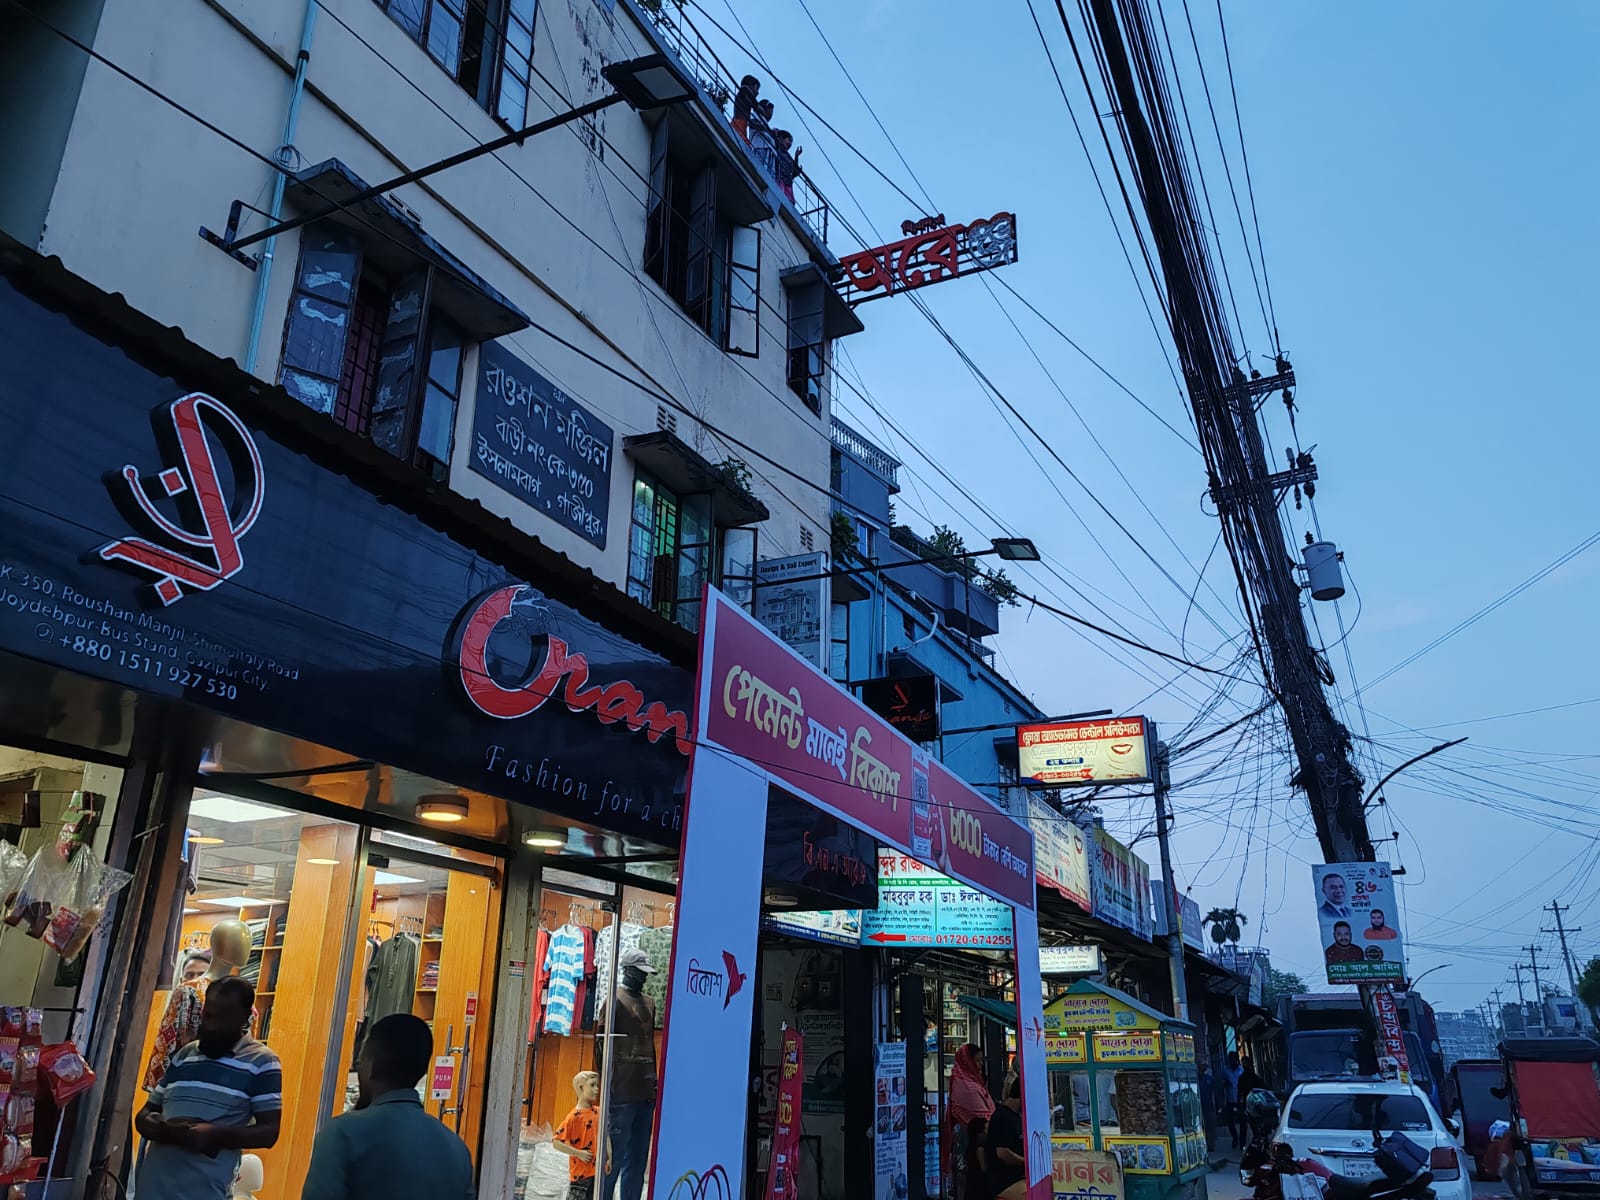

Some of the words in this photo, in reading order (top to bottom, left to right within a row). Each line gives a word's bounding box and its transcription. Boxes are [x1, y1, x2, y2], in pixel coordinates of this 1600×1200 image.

[62, 585, 135, 625] Roushan
[267, 658, 300, 682] Road
[60, 634, 113, 662] +880
[119, 650, 162, 679] 1511
[168, 665, 202, 689] 927
[205, 678, 238, 701] 530
[242, 669, 268, 693] City
[459, 584, 691, 757] Oran
[723, 664, 805, 751] পেমেন্ট
[806, 716, 848, 780] মানেই
[850, 725, 901, 812] বিকাশ
[486, 744, 588, 801] Fashion
[595, 780, 633, 816] for
[641, 804, 652, 822] a
[661, 804, 682, 831] ch
[919, 889, 934, 905] হক
[936, 934, 1013, 946] 01720-674255
[686, 957, 724, 999] বিকাশ
